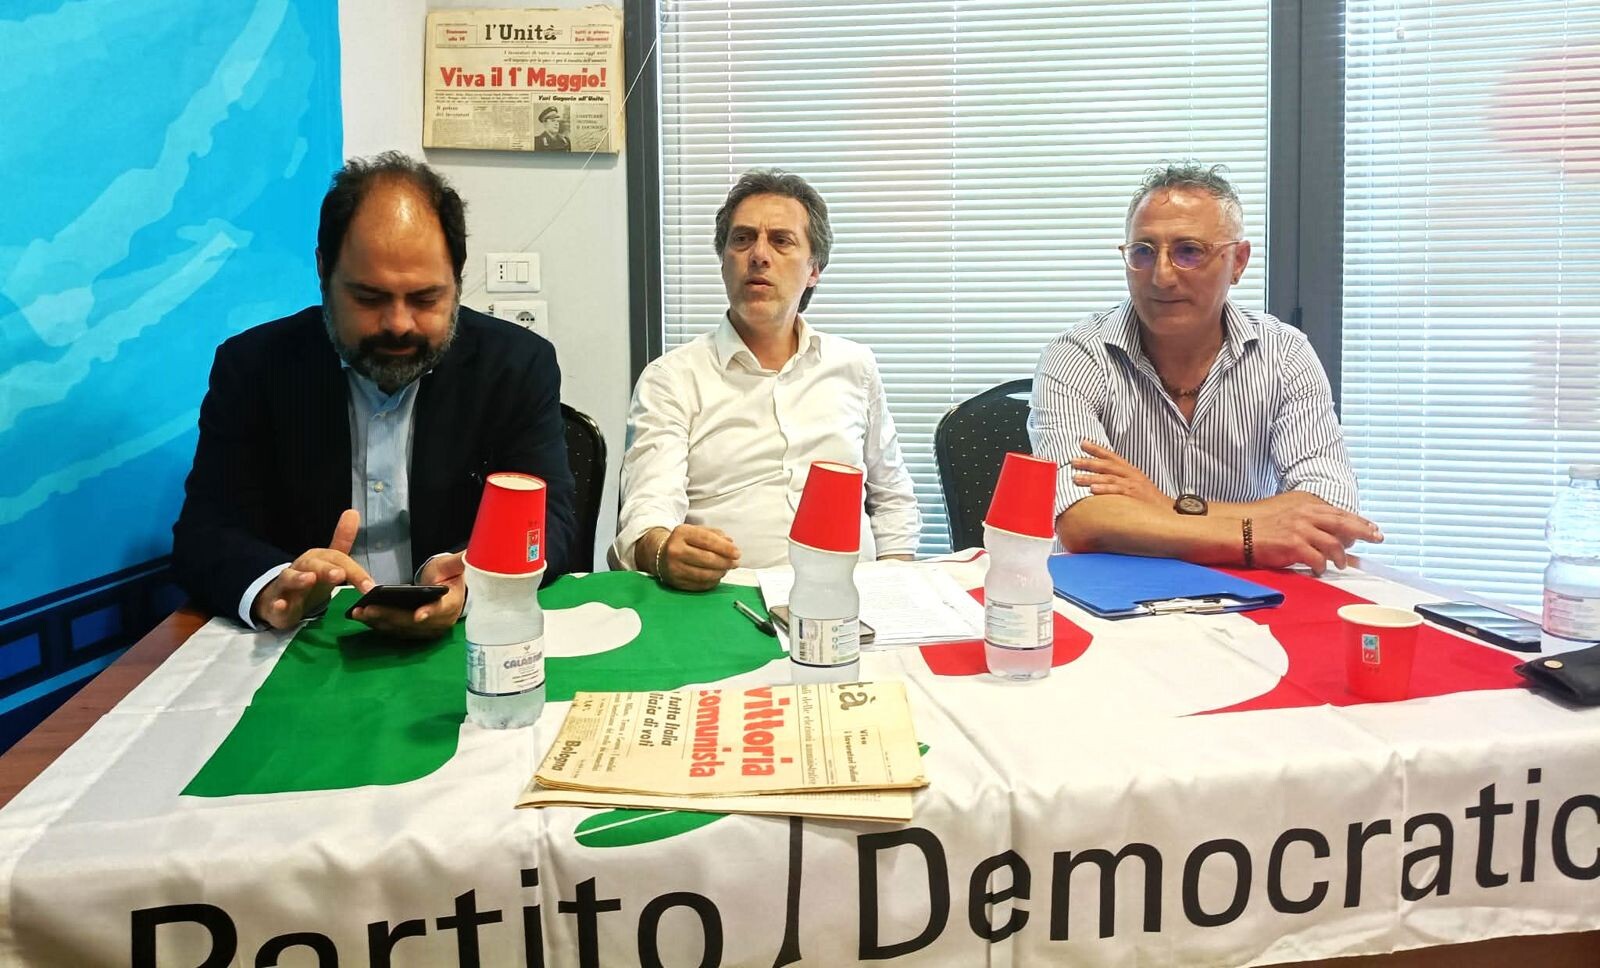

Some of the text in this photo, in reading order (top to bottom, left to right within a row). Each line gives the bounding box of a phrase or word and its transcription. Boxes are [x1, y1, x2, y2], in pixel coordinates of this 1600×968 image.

[485, 24, 557, 40] l'Unità
[440, 67, 485, 87] Viva
[491, 67, 503, 87] il
[527, 67, 607, 92] Maggio!
[661, 722, 680, 747] Italia
[742, 686, 793, 777] vittoria
[550, 740, 583, 771] Bologna
